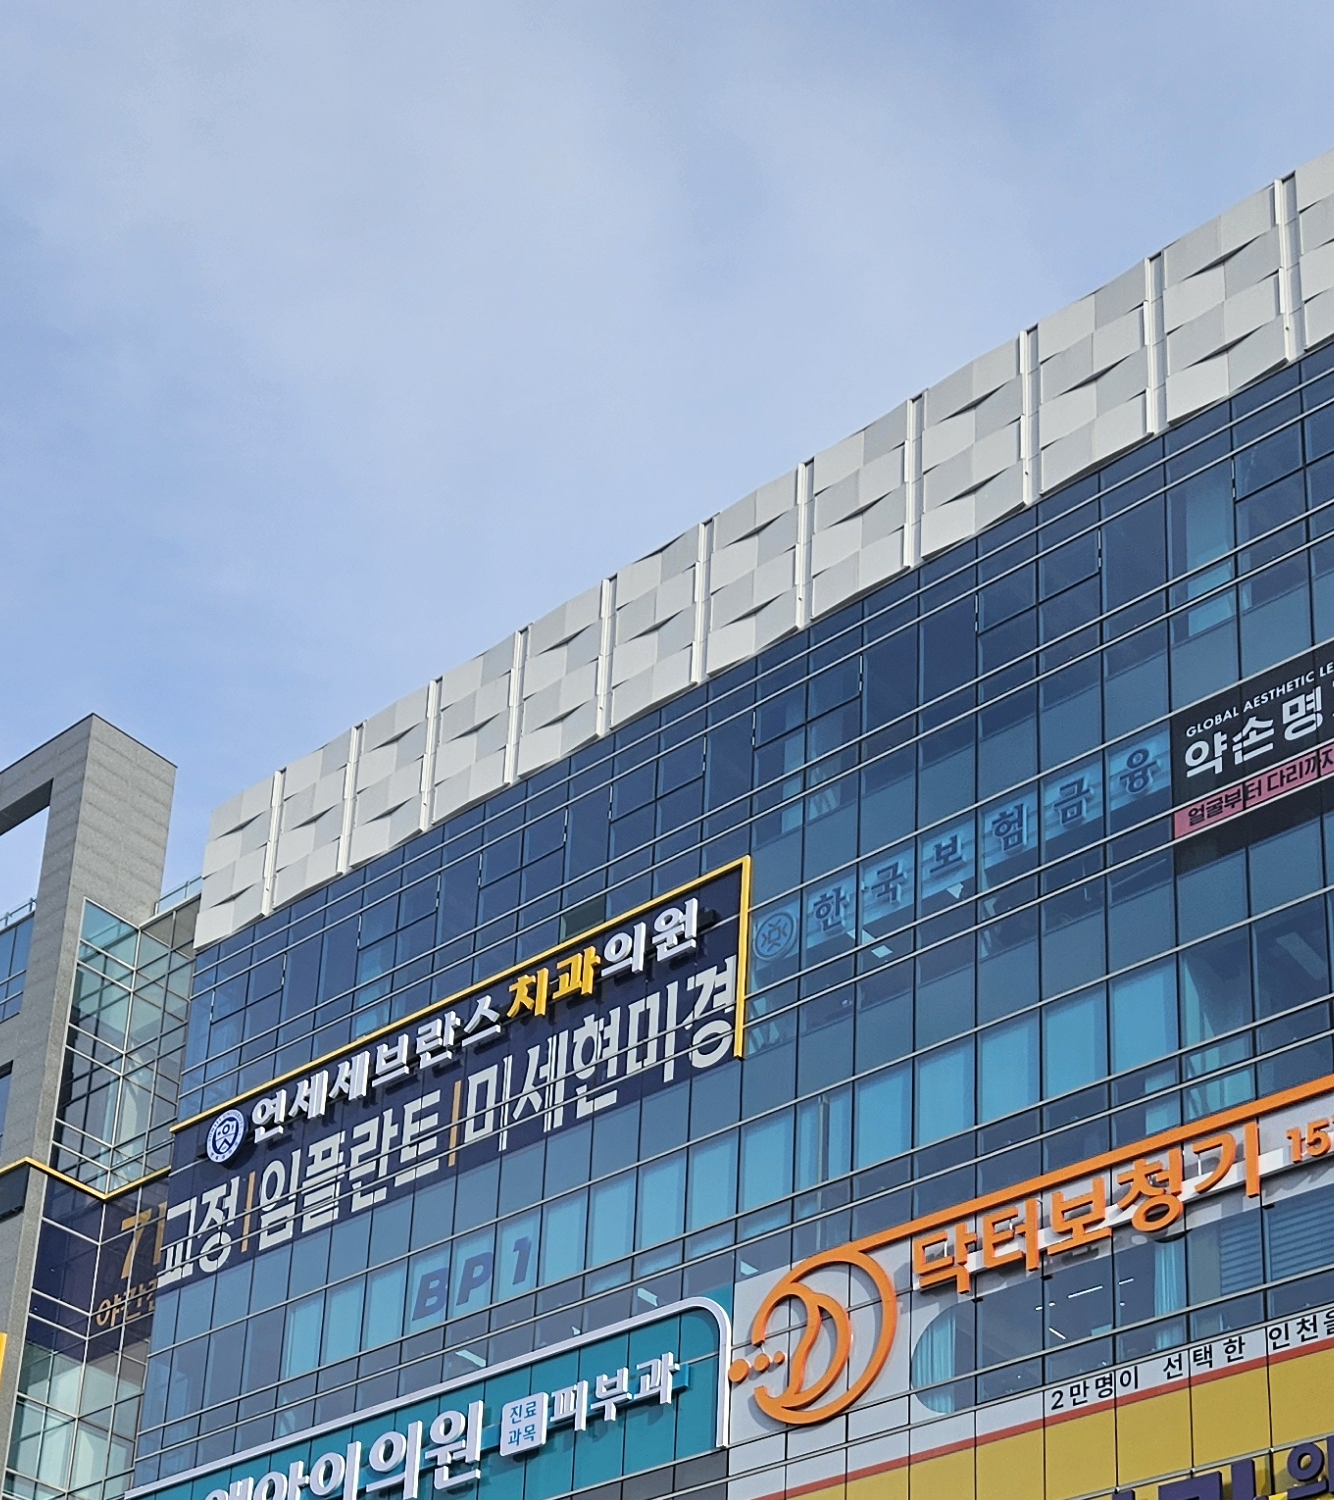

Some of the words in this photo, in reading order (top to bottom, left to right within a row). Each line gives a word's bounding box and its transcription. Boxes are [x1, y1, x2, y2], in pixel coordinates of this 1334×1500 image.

[1185, 706, 1239, 738] GLOBAL
[1242, 668, 1316, 715] AESTHETIC
[813, 745, 1162, 933] 한국보험금융
[1187, 778, 1264, 829] 얼굴부터
[251, 898, 698, 1143] 연세세브란스치과의원
[157, 1176, 240, 1288] 교정
[258, 1089, 443, 1252] 임플란트
[464, 956, 736, 1150] 미세현미경
[912, 1121, 1261, 1296] 닥터보청기
[509, 1399, 539, 1424] 진료
[551, 1351, 680, 1432] 피부과
[1050, 1367, 1140, 1411] 2만명이
[1162, 1340, 1247, 1380] 선택한
[507, 1423, 538, 1448] 과목
